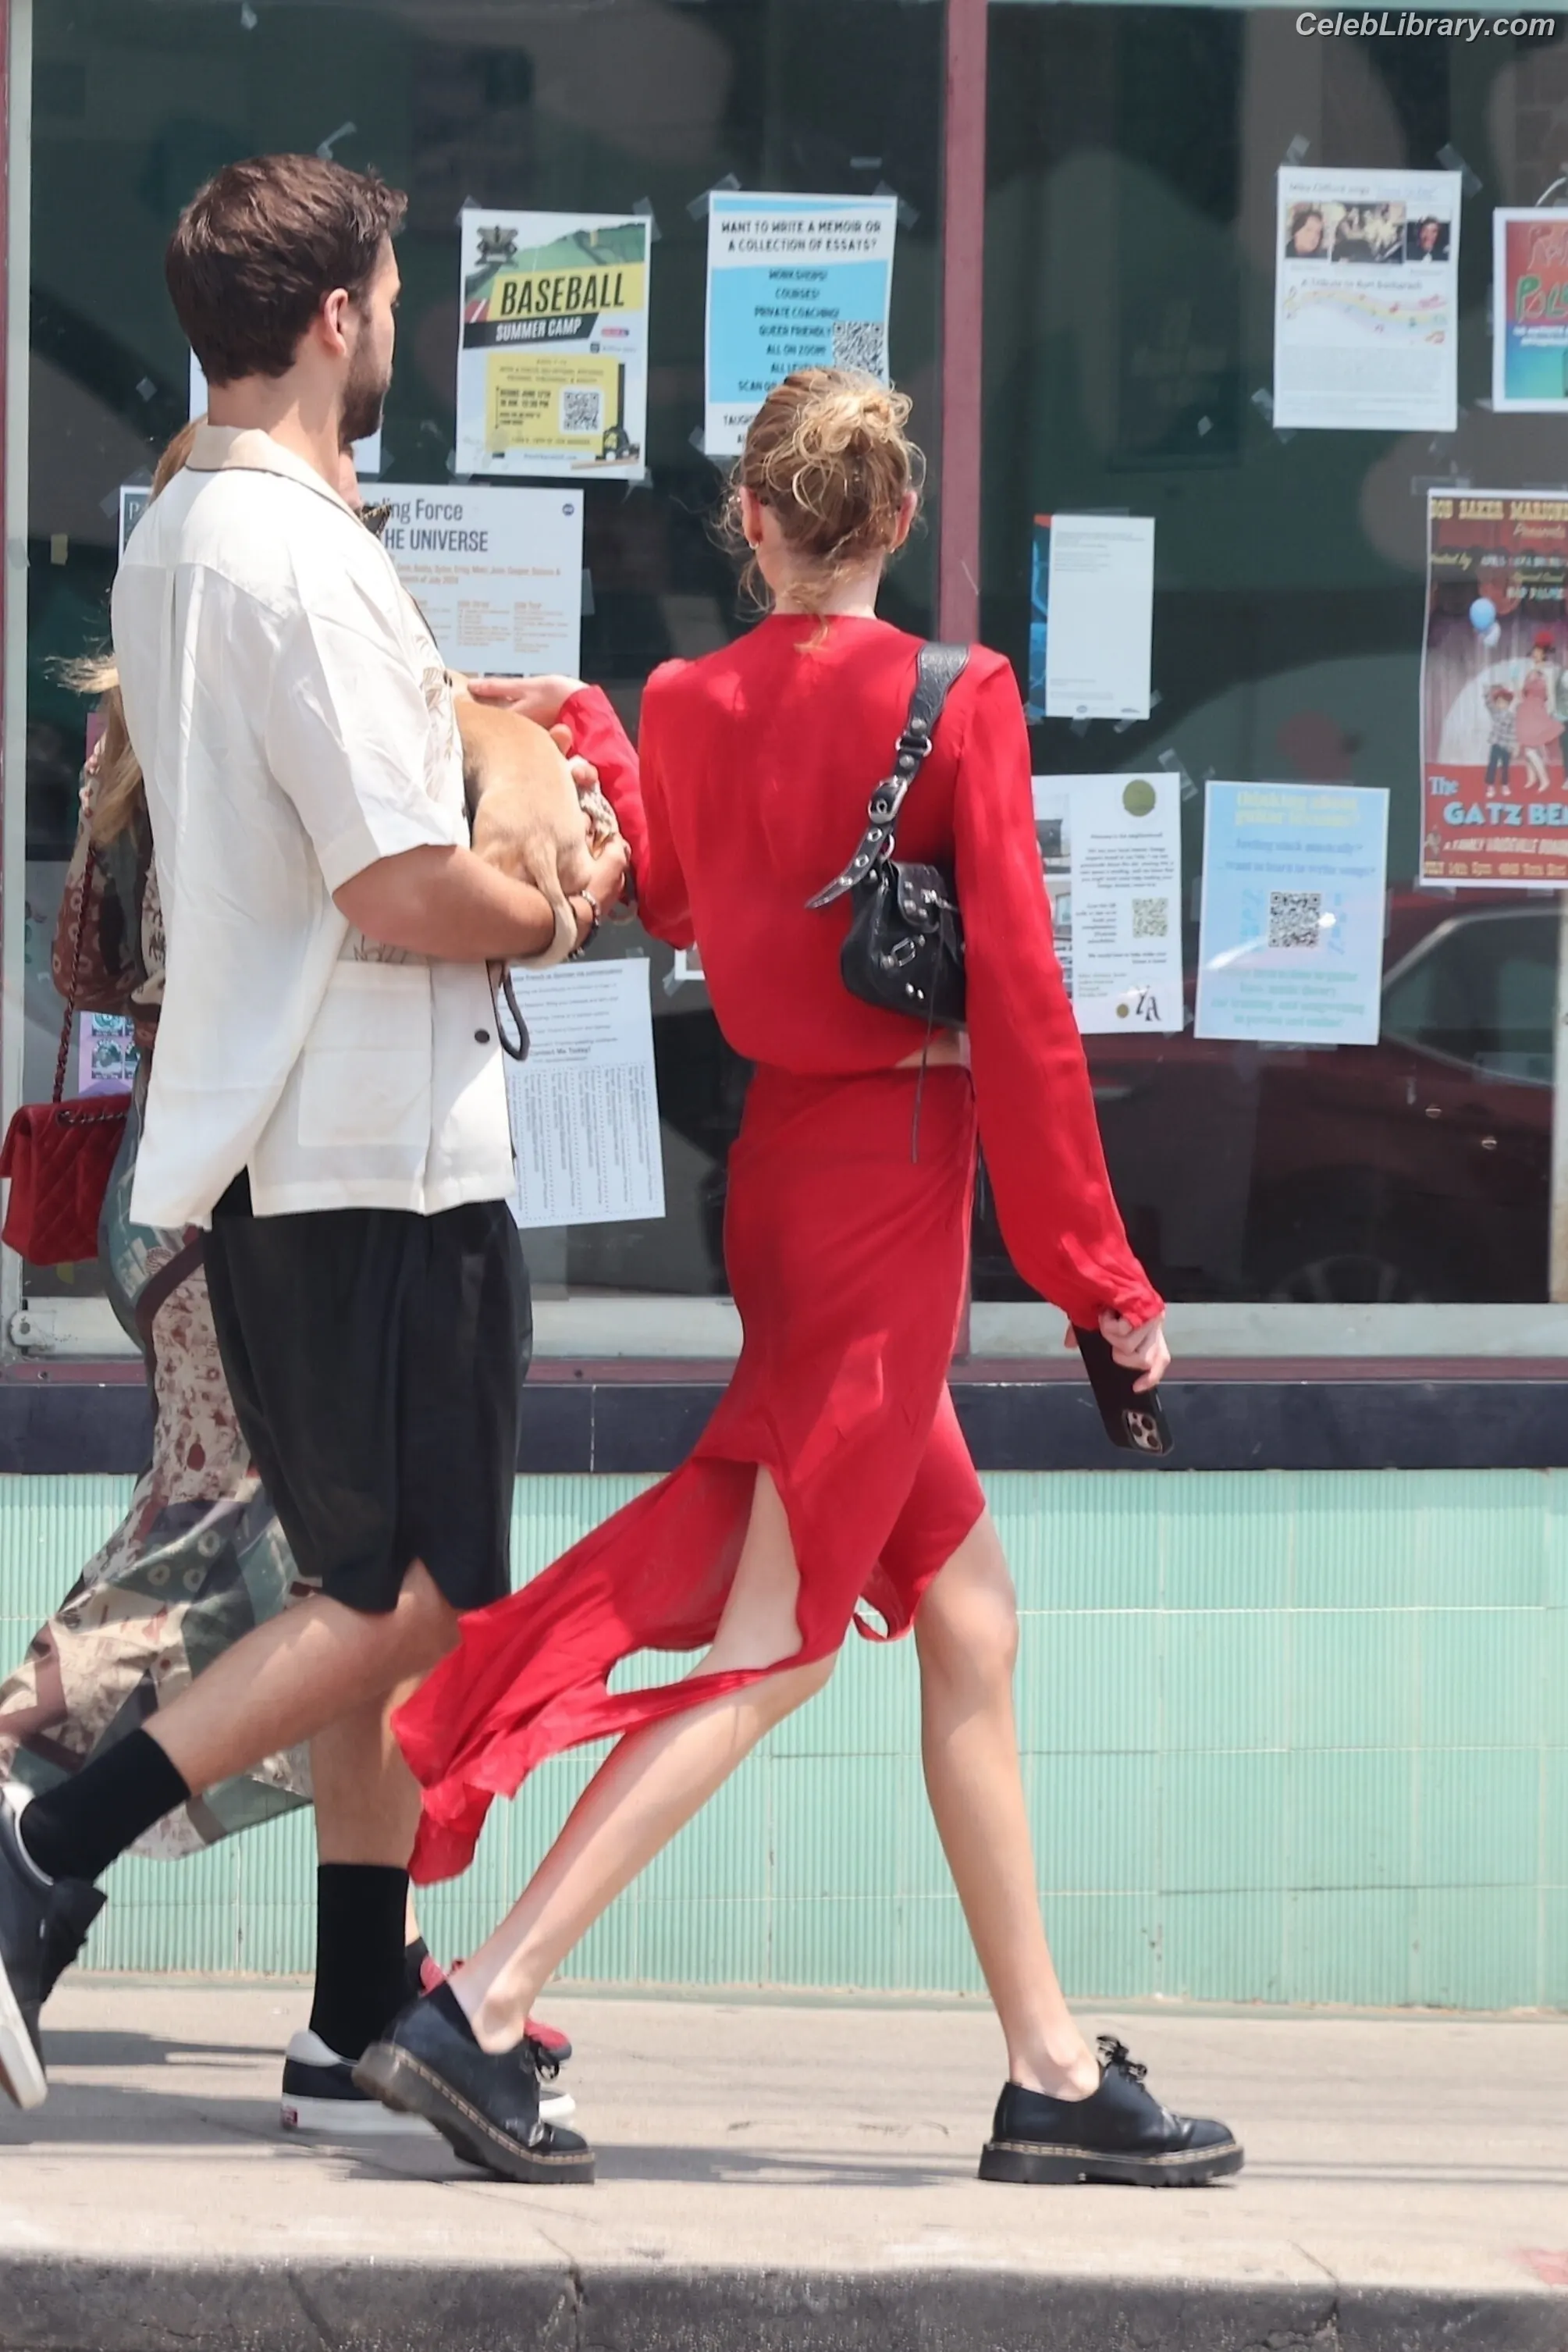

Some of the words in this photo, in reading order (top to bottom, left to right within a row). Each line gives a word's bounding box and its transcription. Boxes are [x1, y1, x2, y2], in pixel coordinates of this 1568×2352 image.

[722, 220, 751, 233] WANT
[756, 220, 768, 233] TO
[772, 219, 803, 233] WRITE
[808, 220, 814, 233] A
[818, 220, 861, 233] MEMOIR
[866, 220, 881, 233] OR
[728, 238, 735, 251] A
[739, 238, 805, 251] COLLECTION
[809, 238, 823, 251] OF
[827, 238, 877, 252] ESSAYS?
[500, 273, 624, 316] BASEBALL
[496, 320, 546, 342] SUMMER
[548, 316, 581, 336] CAMP
[416, 498, 463, 521] Force
[385, 528, 404, 550] HE
[410, 528, 489, 553] UNIVERSE
[1428, 776, 1459, 795] The
[1444, 802, 1524, 826] GATZ
